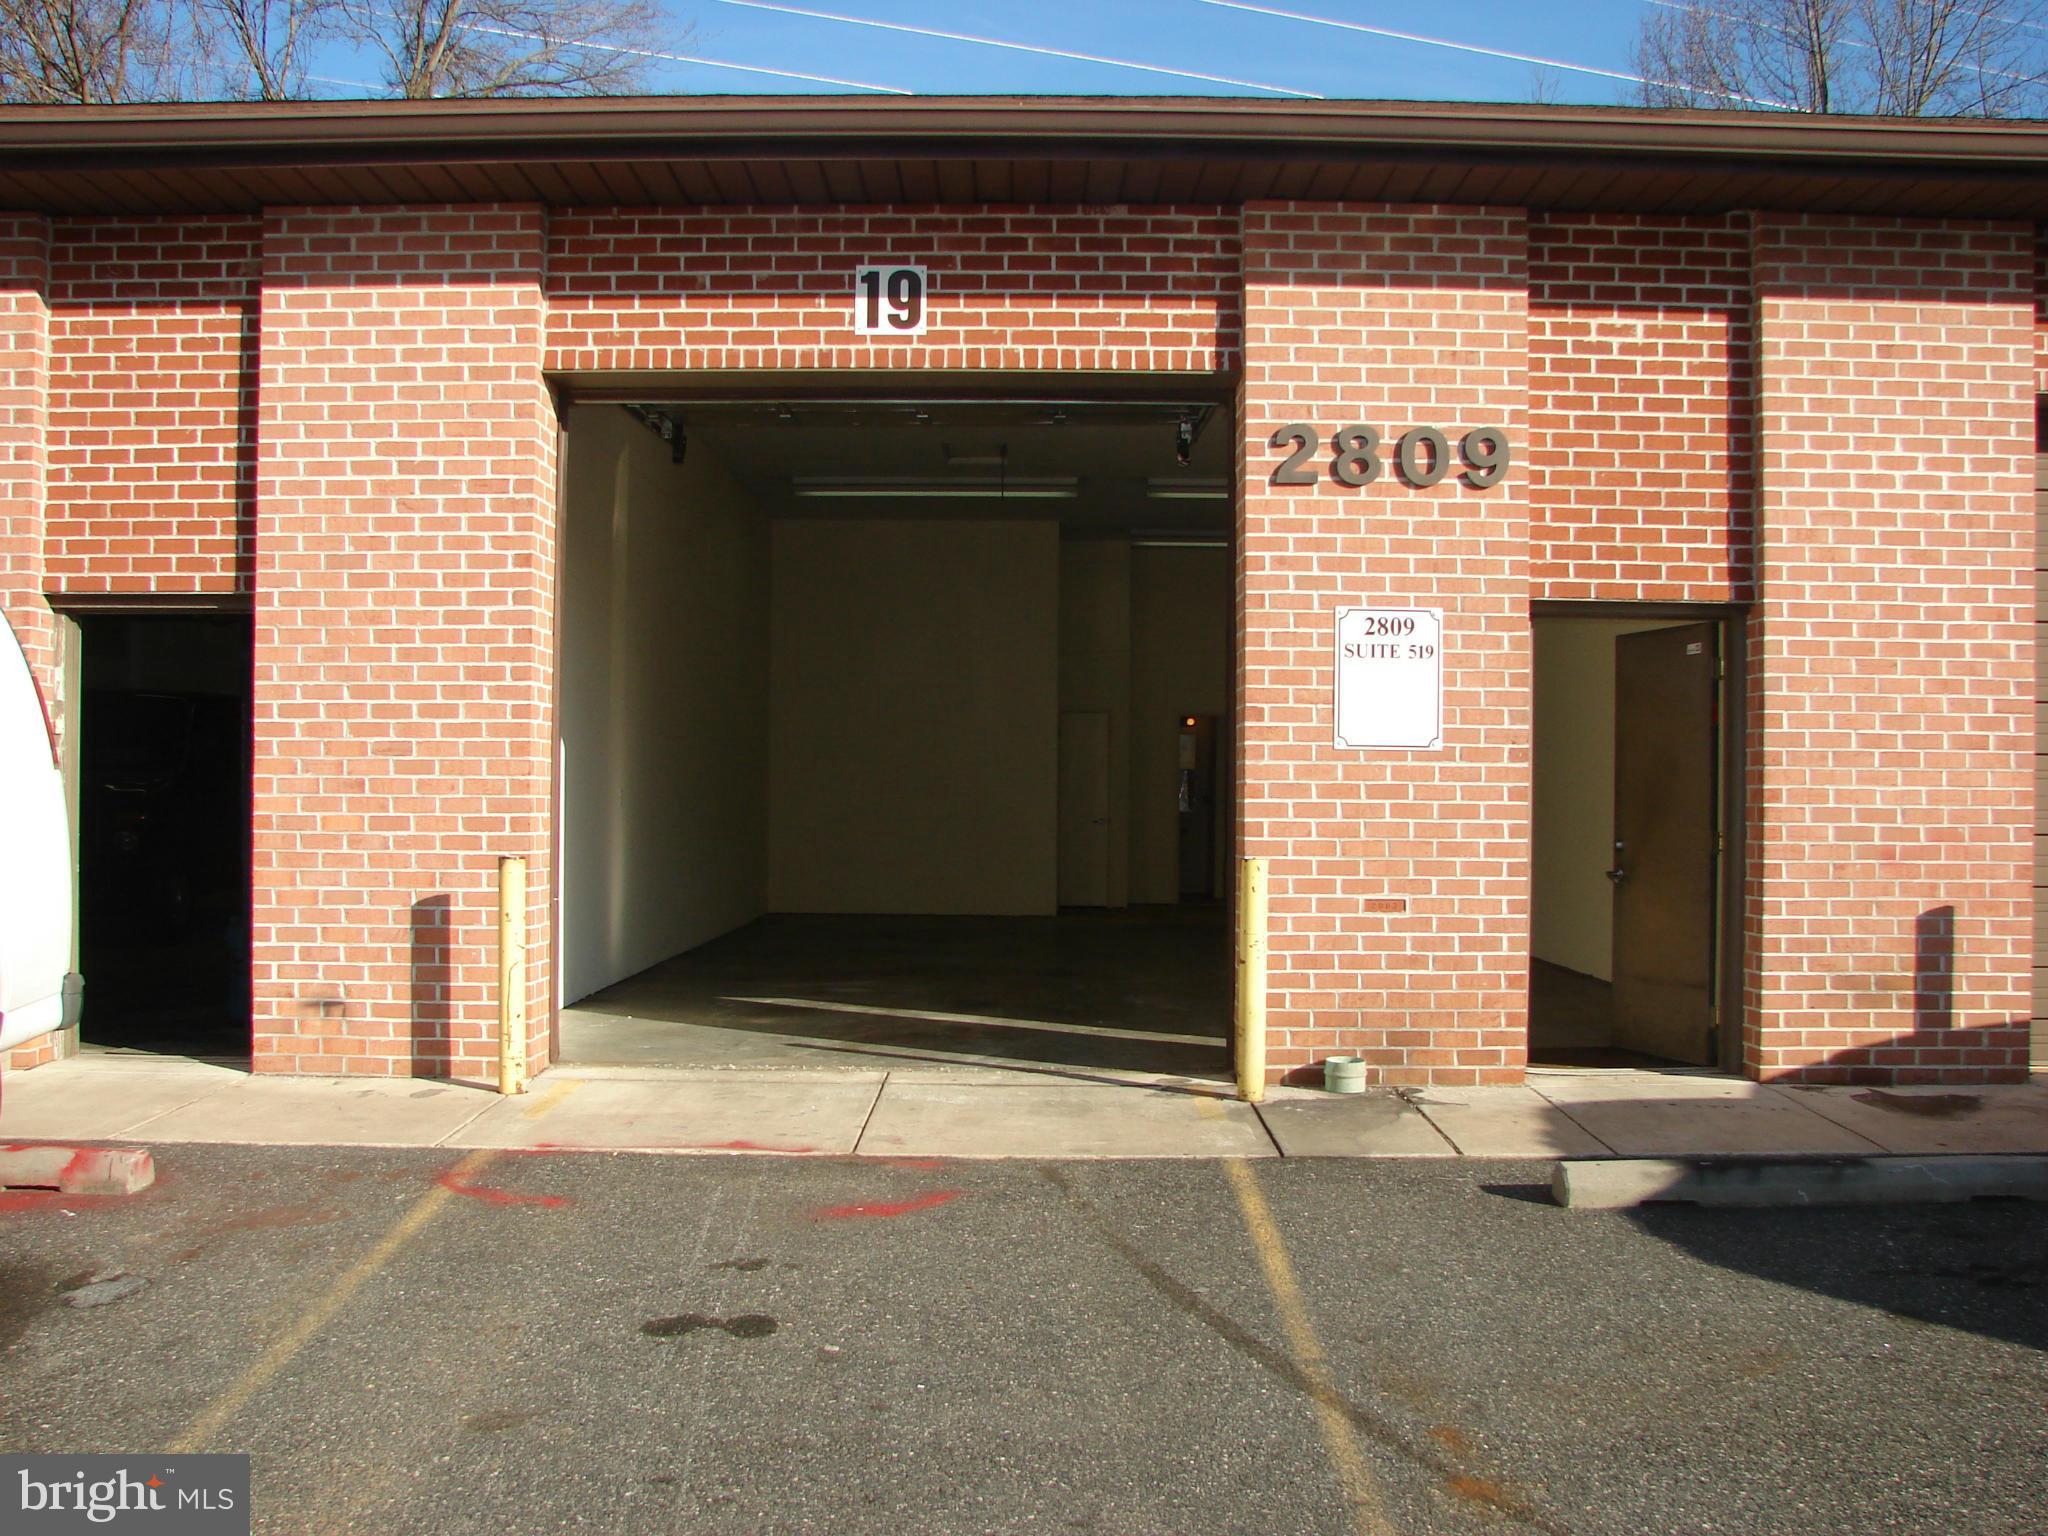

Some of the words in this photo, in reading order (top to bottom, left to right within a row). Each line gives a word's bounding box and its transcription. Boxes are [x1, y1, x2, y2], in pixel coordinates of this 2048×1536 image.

[860, 270, 922, 330] 19
[1267, 423, 1511, 490] 2809
[1364, 616, 1415, 636] 2809
[1344, 643, 1400, 659] SUITE
[1408, 644, 1434, 659] 519
